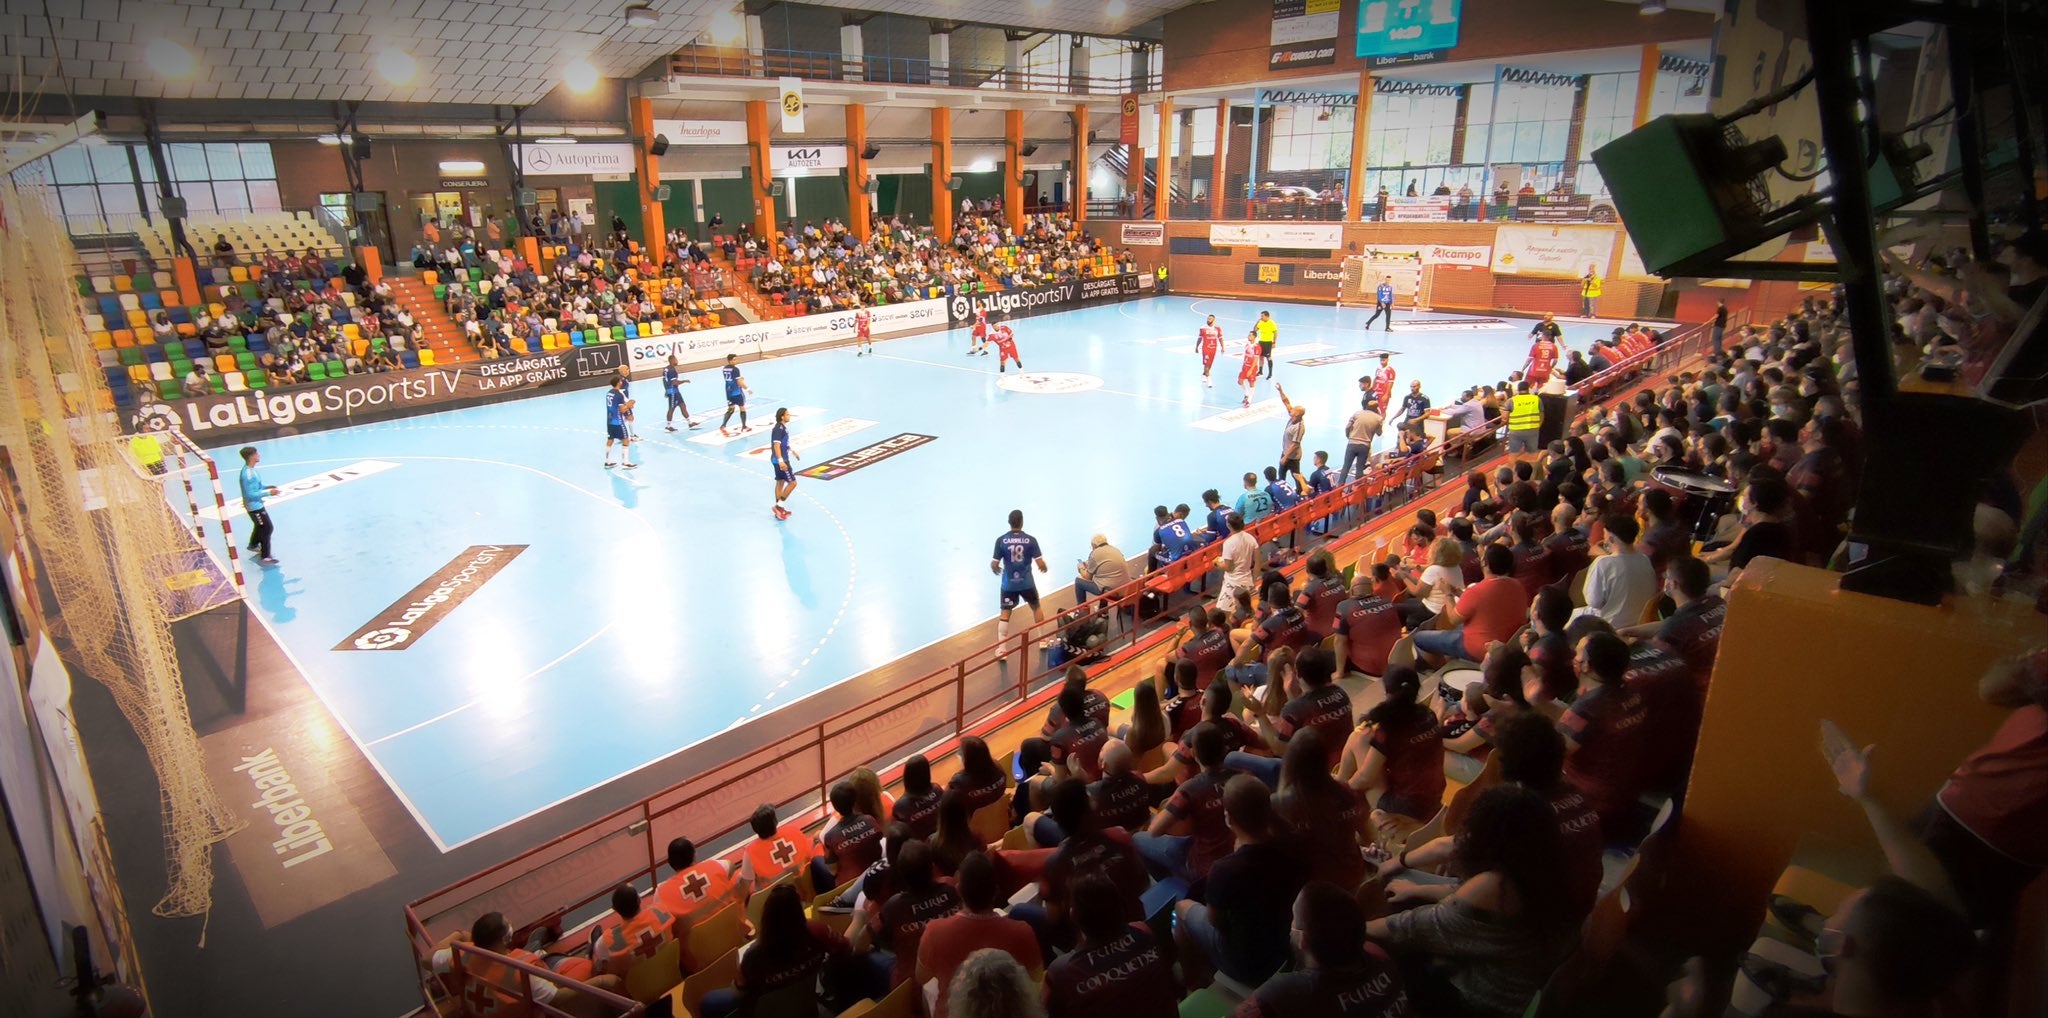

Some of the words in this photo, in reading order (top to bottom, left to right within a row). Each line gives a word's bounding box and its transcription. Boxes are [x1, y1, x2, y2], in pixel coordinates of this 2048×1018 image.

[679, 122, 721, 139] Incarlopsa
[556, 153, 619, 168] Autoprima
[788, 159, 821, 167] AUTOZETA
[442, 180, 488, 188] CONSERJERIA
[1431, 247, 1482, 260] Alcampo
[1303, 269, 1350, 281] Liberbak
[480, 355, 562, 377] DESCÁRGATE
[591, 350, 611, 366] TV
[478, 377, 496, 391] LA
[499, 375, 523, 388] APP
[526, 367, 568, 383] GRATIS
[1253, 497, 1268, 513] 23
[1171, 524, 1186, 538] 8
[1007, 544, 1025, 563] 18
[232, 747, 334, 869] Liberbank
